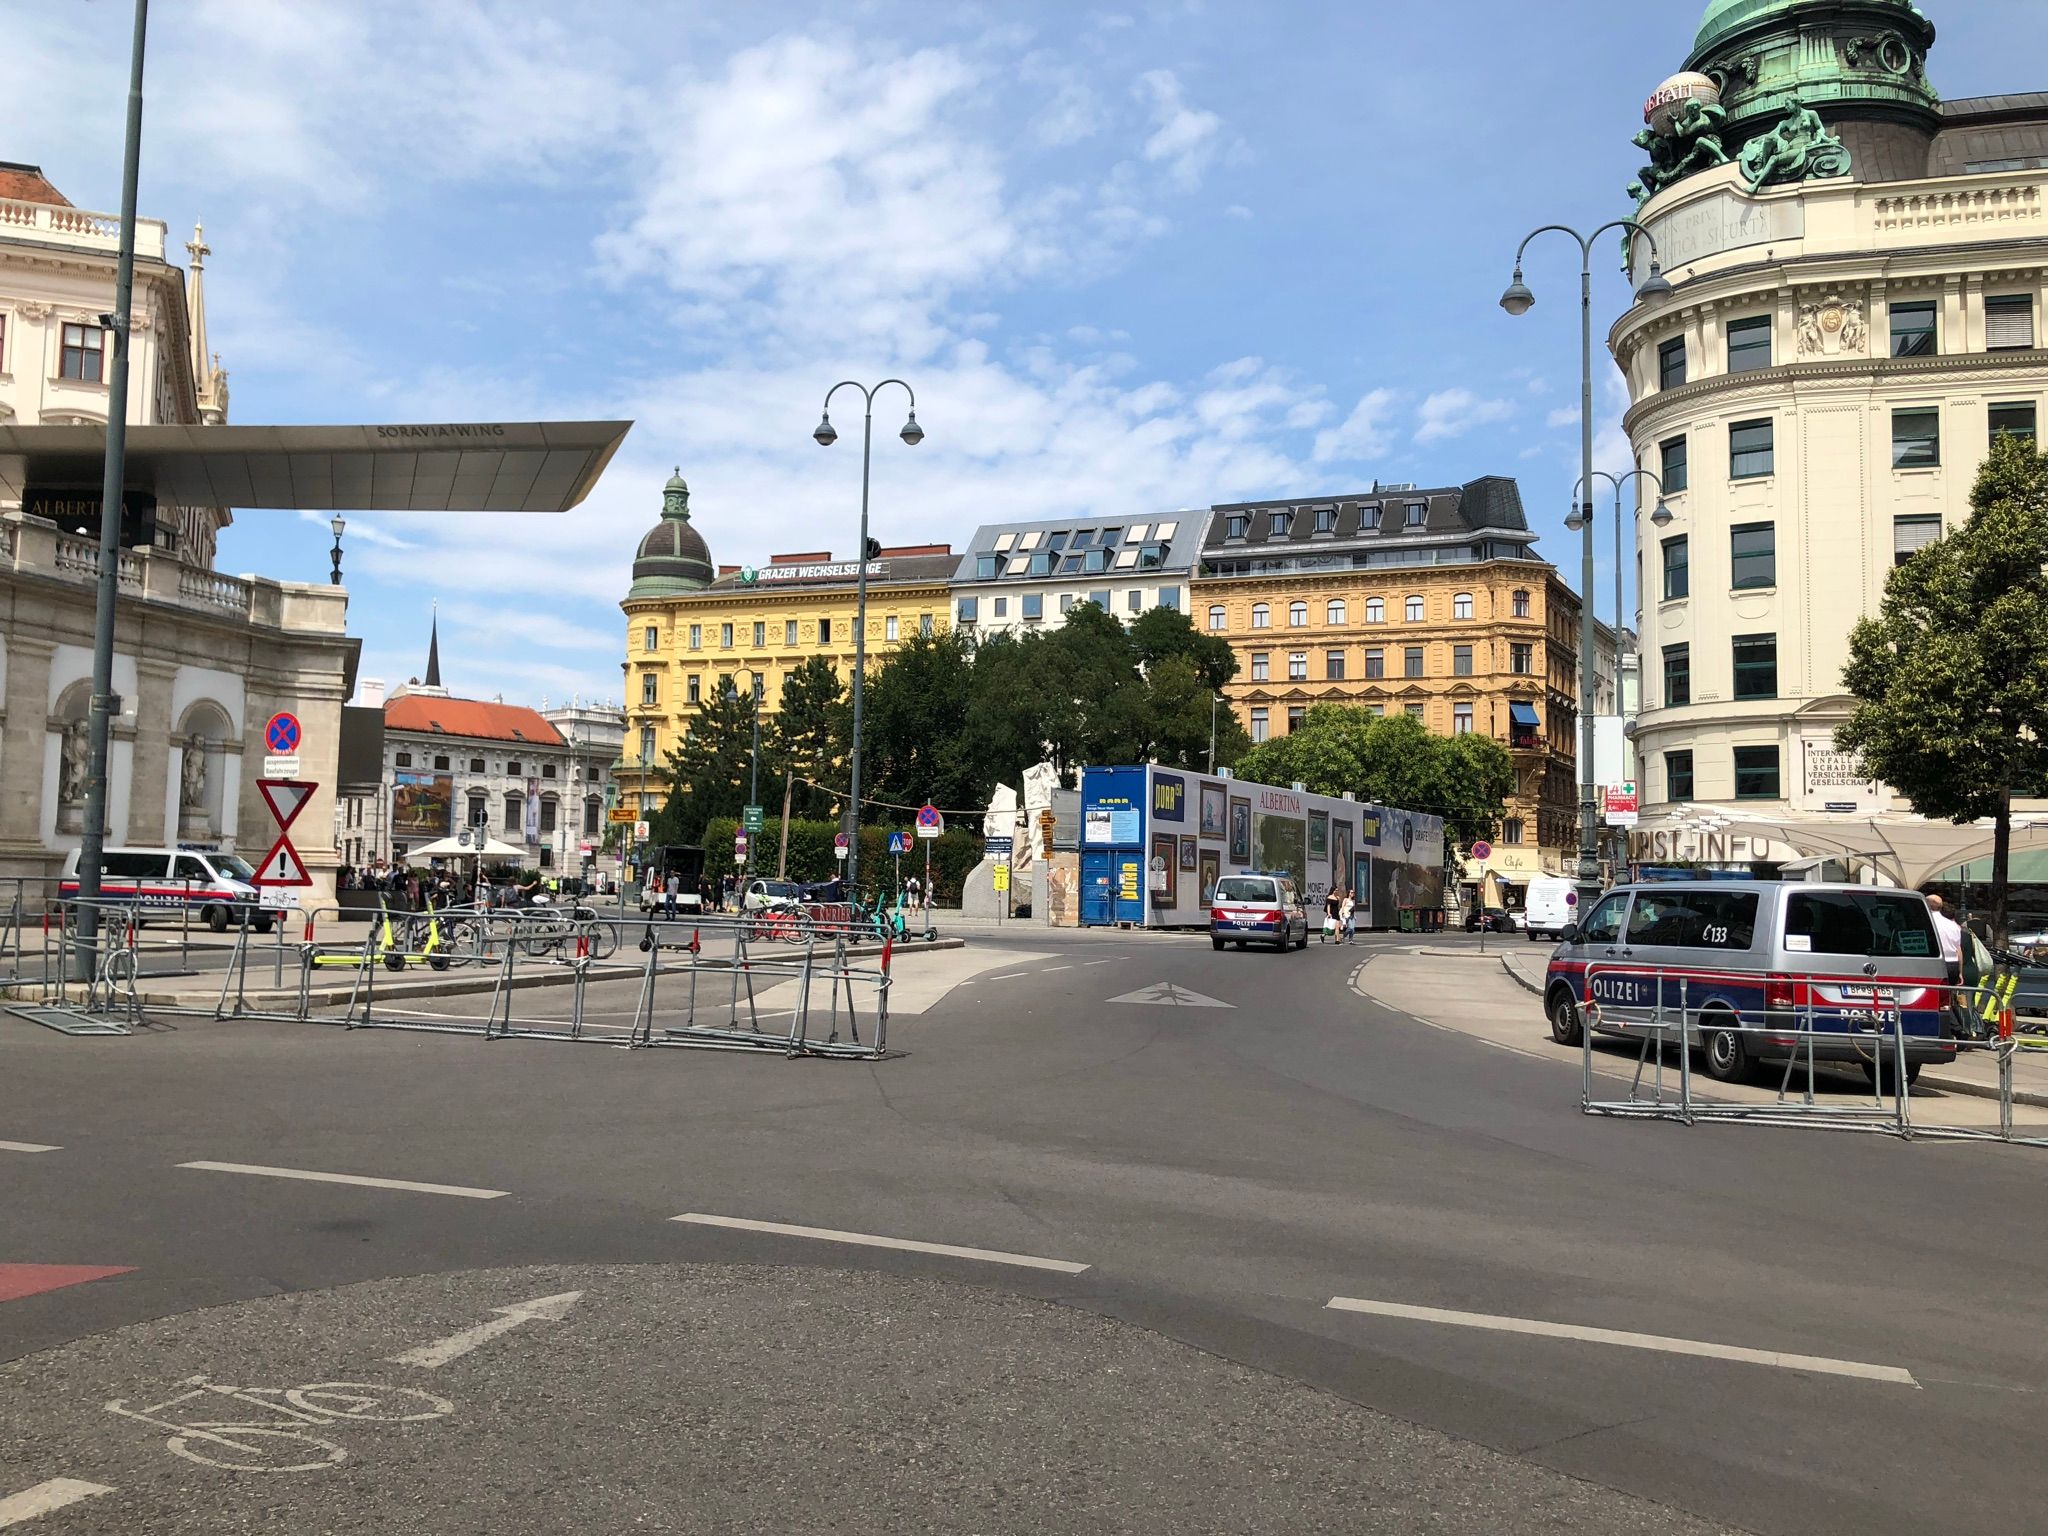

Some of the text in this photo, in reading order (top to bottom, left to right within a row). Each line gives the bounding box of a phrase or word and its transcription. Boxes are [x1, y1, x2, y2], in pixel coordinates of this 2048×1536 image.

[31, 499, 129, 516] ALBERTIA
[758, 562, 883, 580] GRAZER WECHSELSEIIGE
[1260, 792, 1300, 813] ALBERTINA
[1308, 882, 1325, 894] MONET
[1711, 926, 1728, 943] 133
[1593, 978, 1639, 1002] OLIZEI
